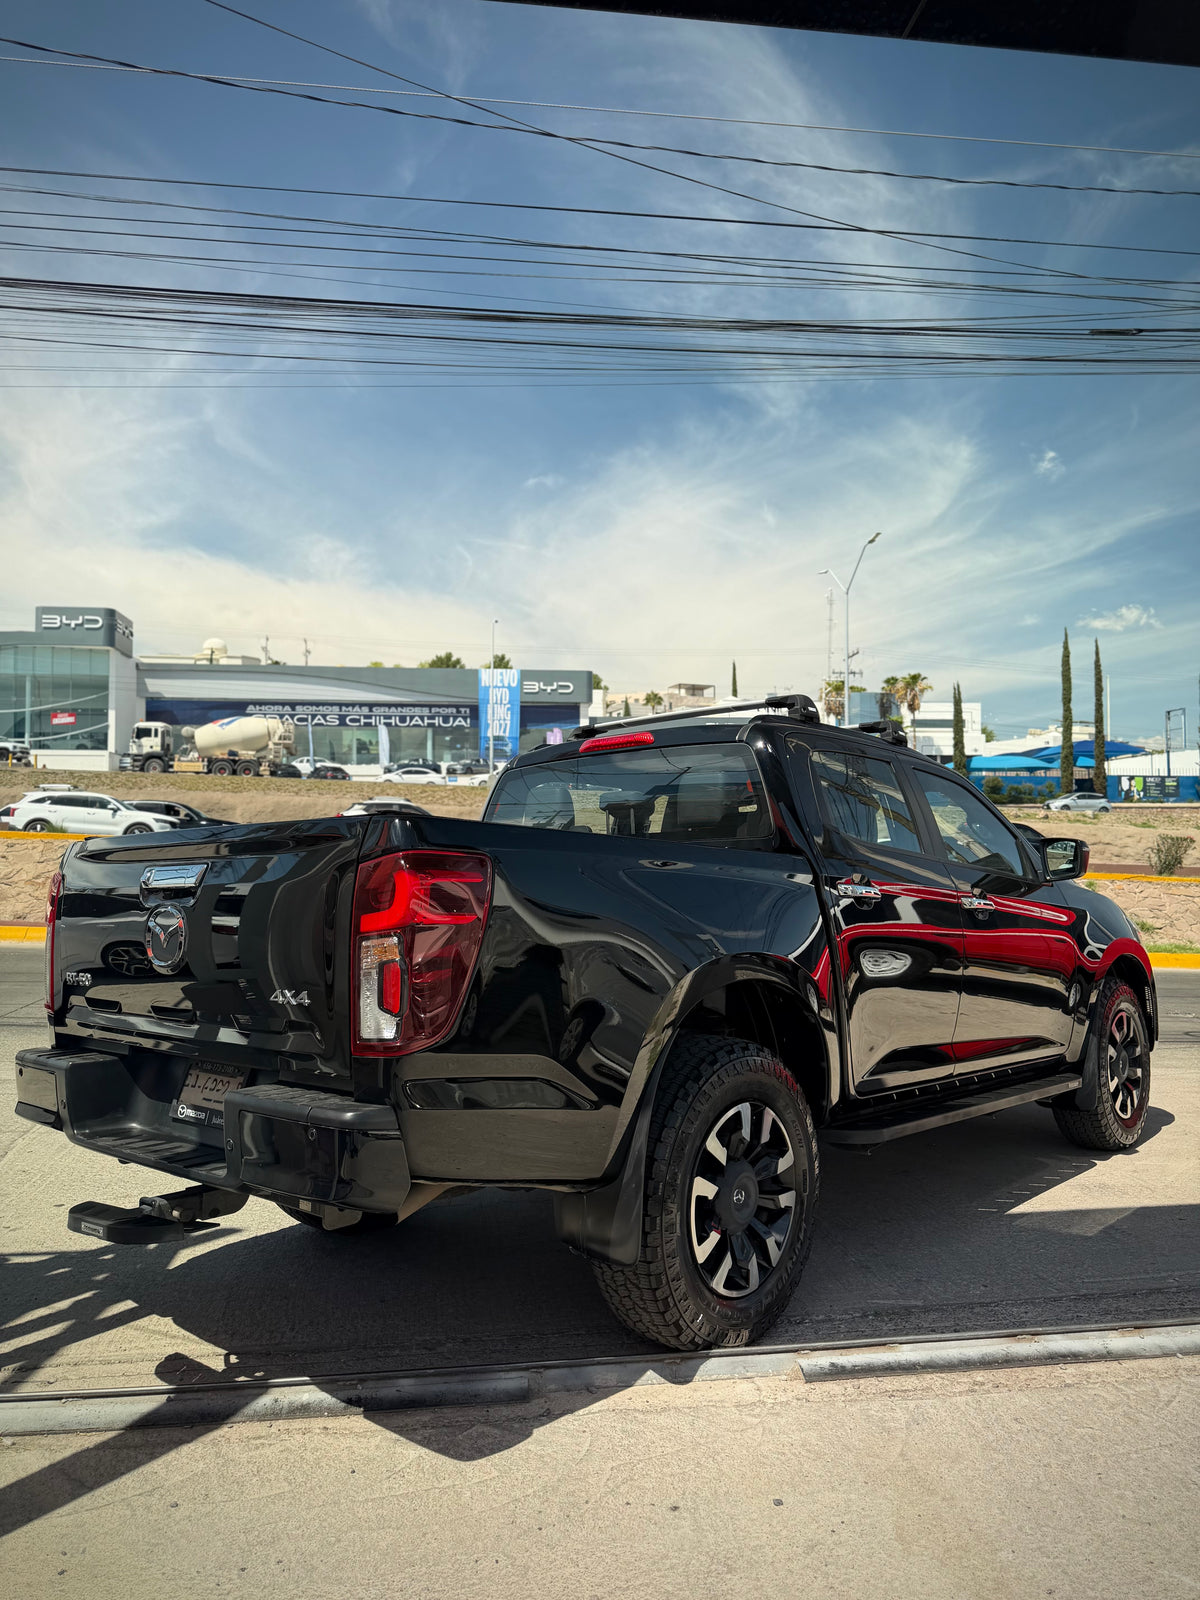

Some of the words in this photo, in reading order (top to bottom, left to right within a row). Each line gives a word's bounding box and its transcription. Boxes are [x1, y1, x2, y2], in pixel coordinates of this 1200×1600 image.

[42, 615, 103, 629] BYD
[522, 681, 574, 693] BYD
[246, 704, 292, 712] AHORA
[295, 705, 340, 713] SOMOS
[341, 704, 370, 713] MÁS
[372, 706, 430, 714] GRANDES
[345, 715, 471, 727] CHIHUAHUA!
